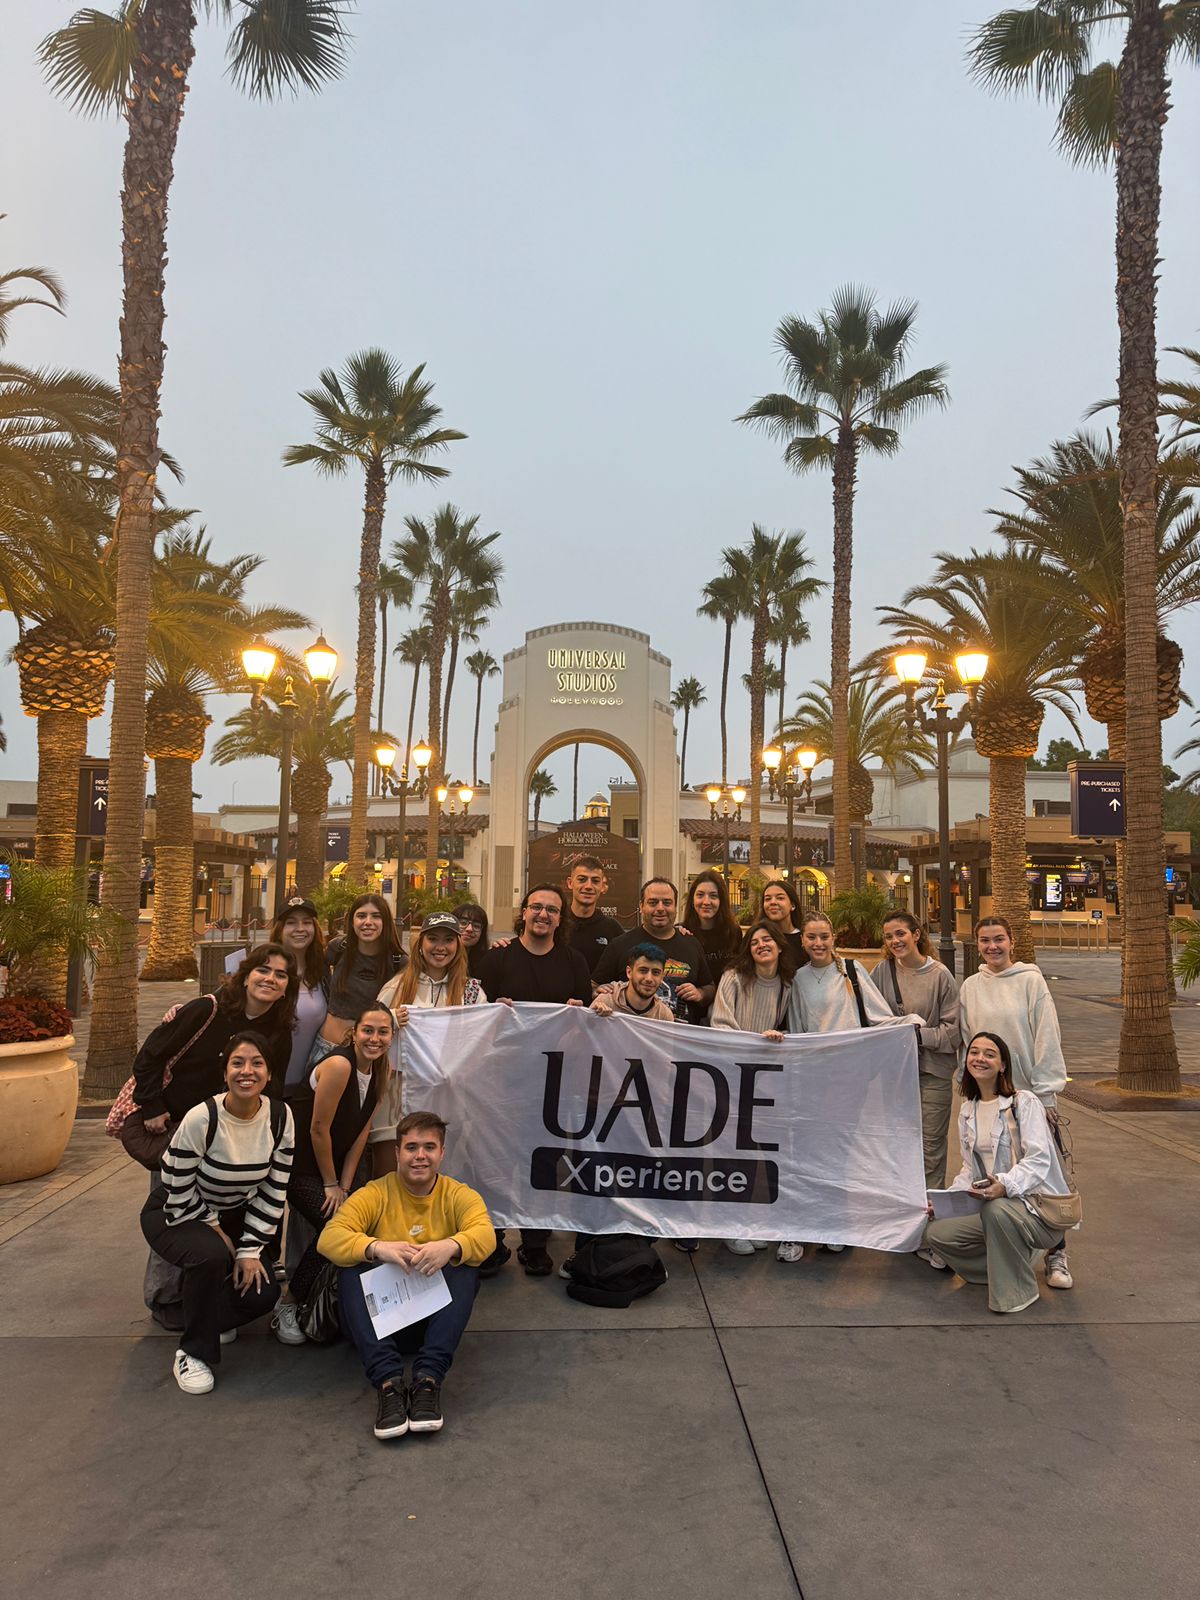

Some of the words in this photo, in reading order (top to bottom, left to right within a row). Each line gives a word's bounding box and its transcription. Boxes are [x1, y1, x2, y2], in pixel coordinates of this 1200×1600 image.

[548, 648, 626, 670] UNIVERSAL
[557, 671, 617, 692] STUDIOS
[550, 696, 624, 706] HOLLYWOOD
[558, 837, 585, 845] HORROR
[542, 1051, 784, 1152] UADE
